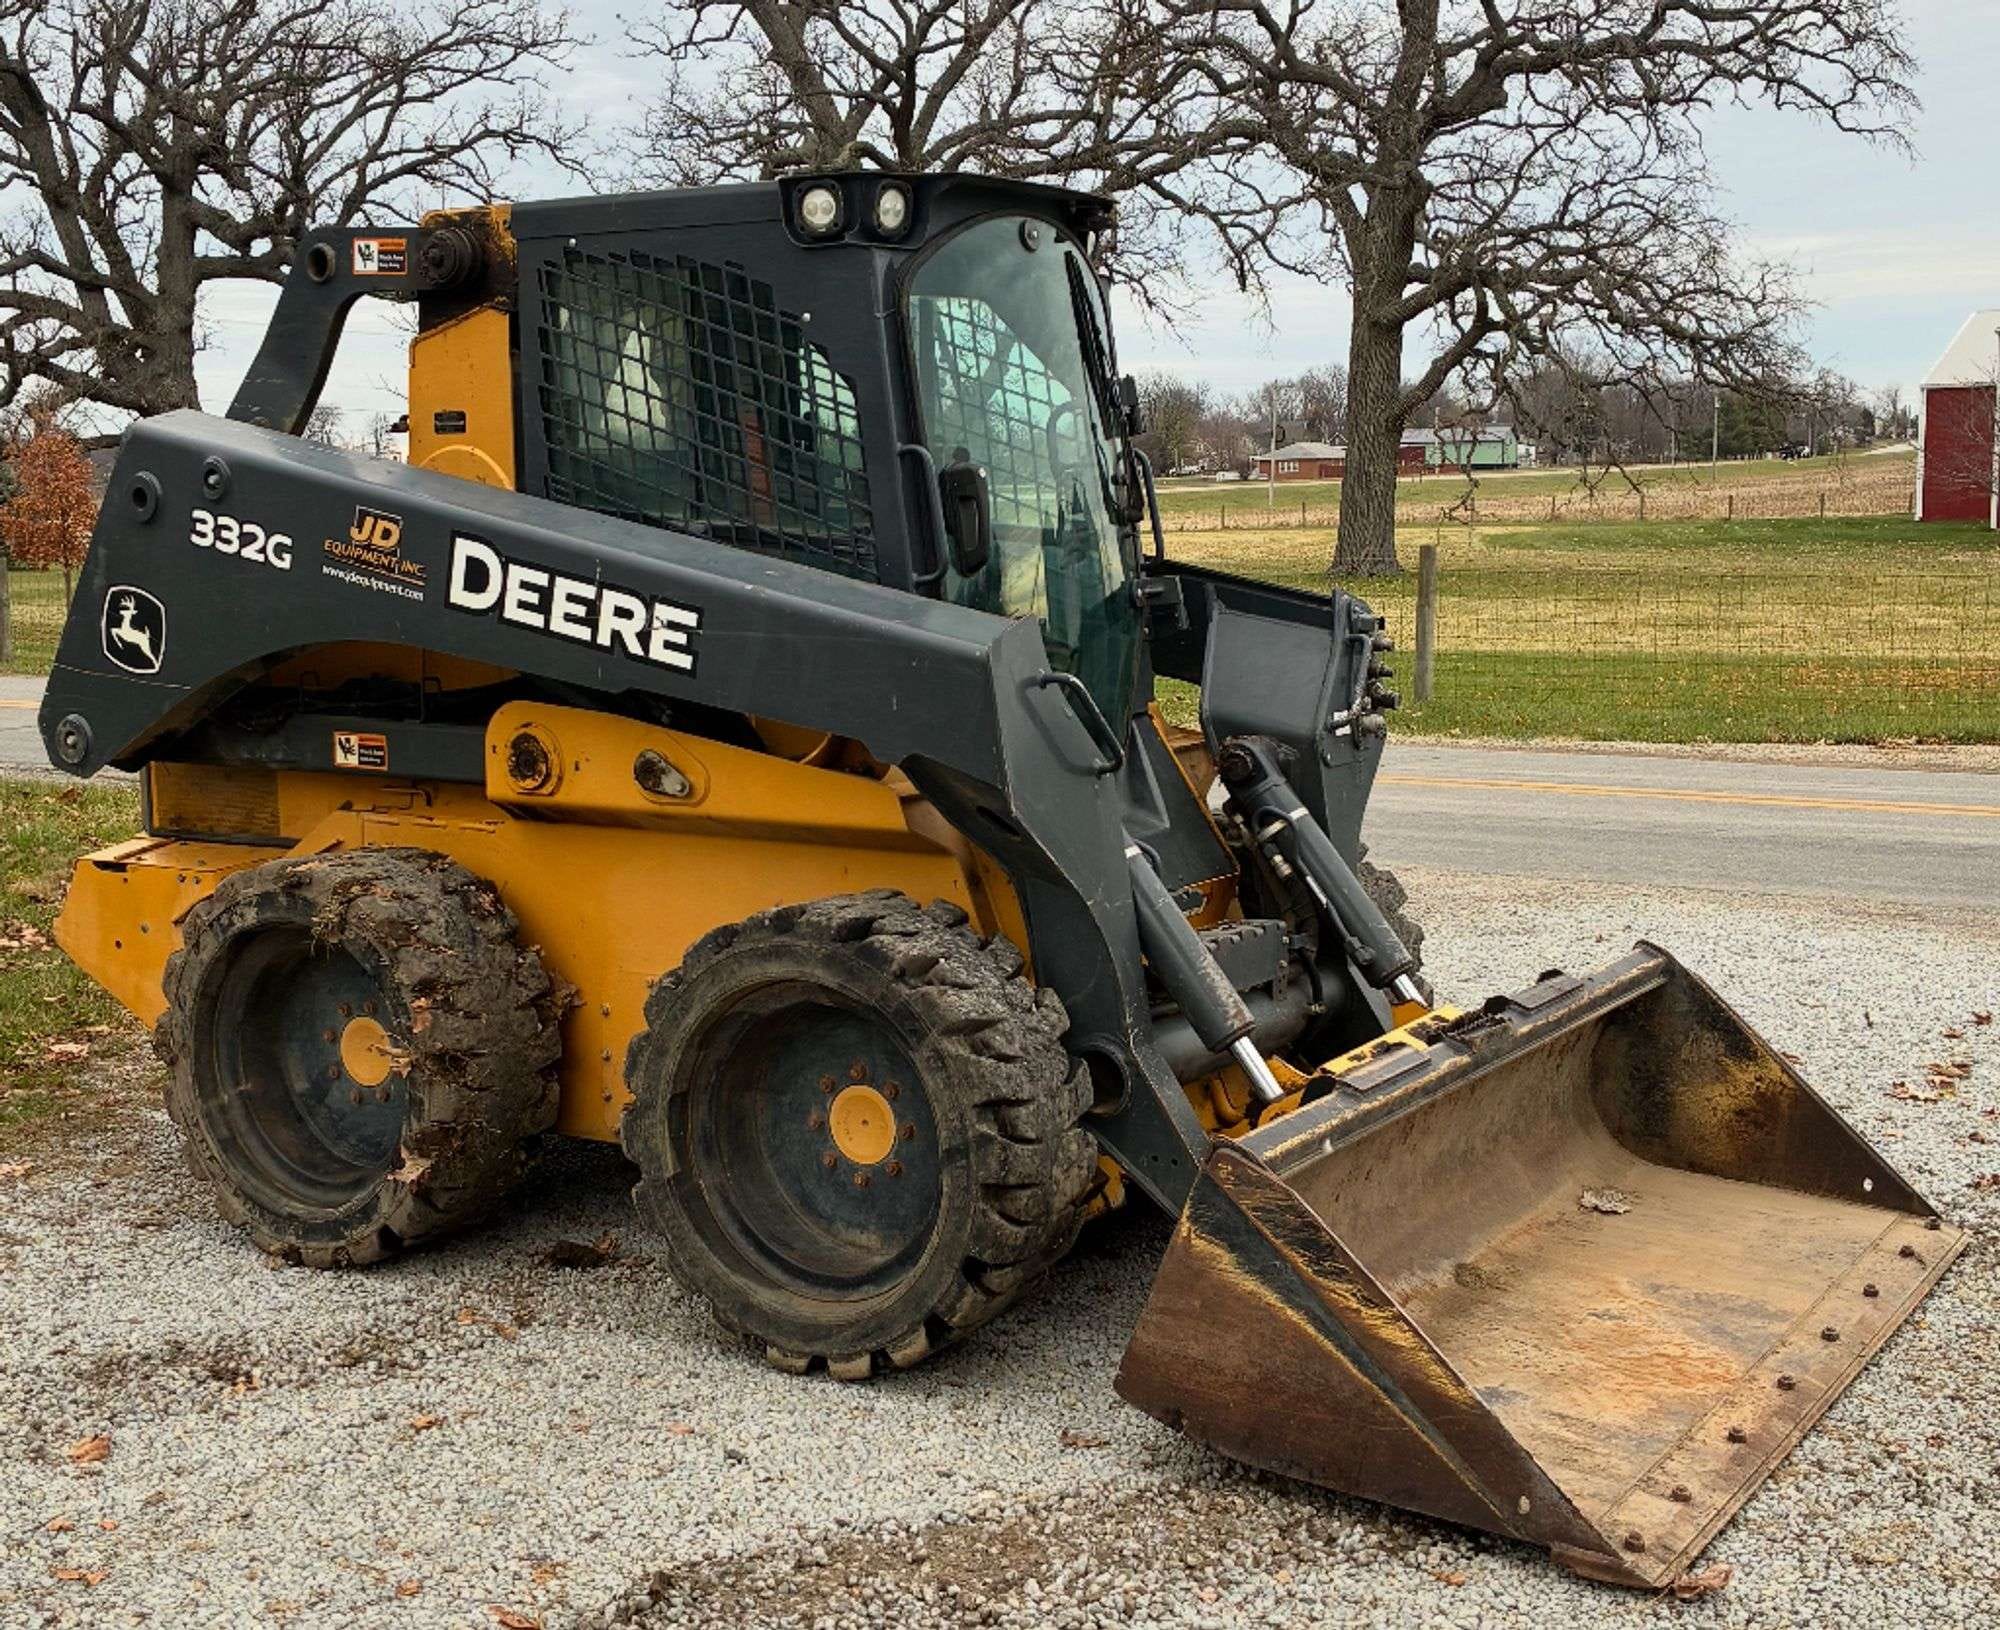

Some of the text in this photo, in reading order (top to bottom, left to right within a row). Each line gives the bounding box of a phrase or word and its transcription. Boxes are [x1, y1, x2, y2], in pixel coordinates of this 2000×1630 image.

[190, 509, 293, 570] 332G
[350, 516, 400, 548] JD
[450, 537, 699, 670] DEERE
